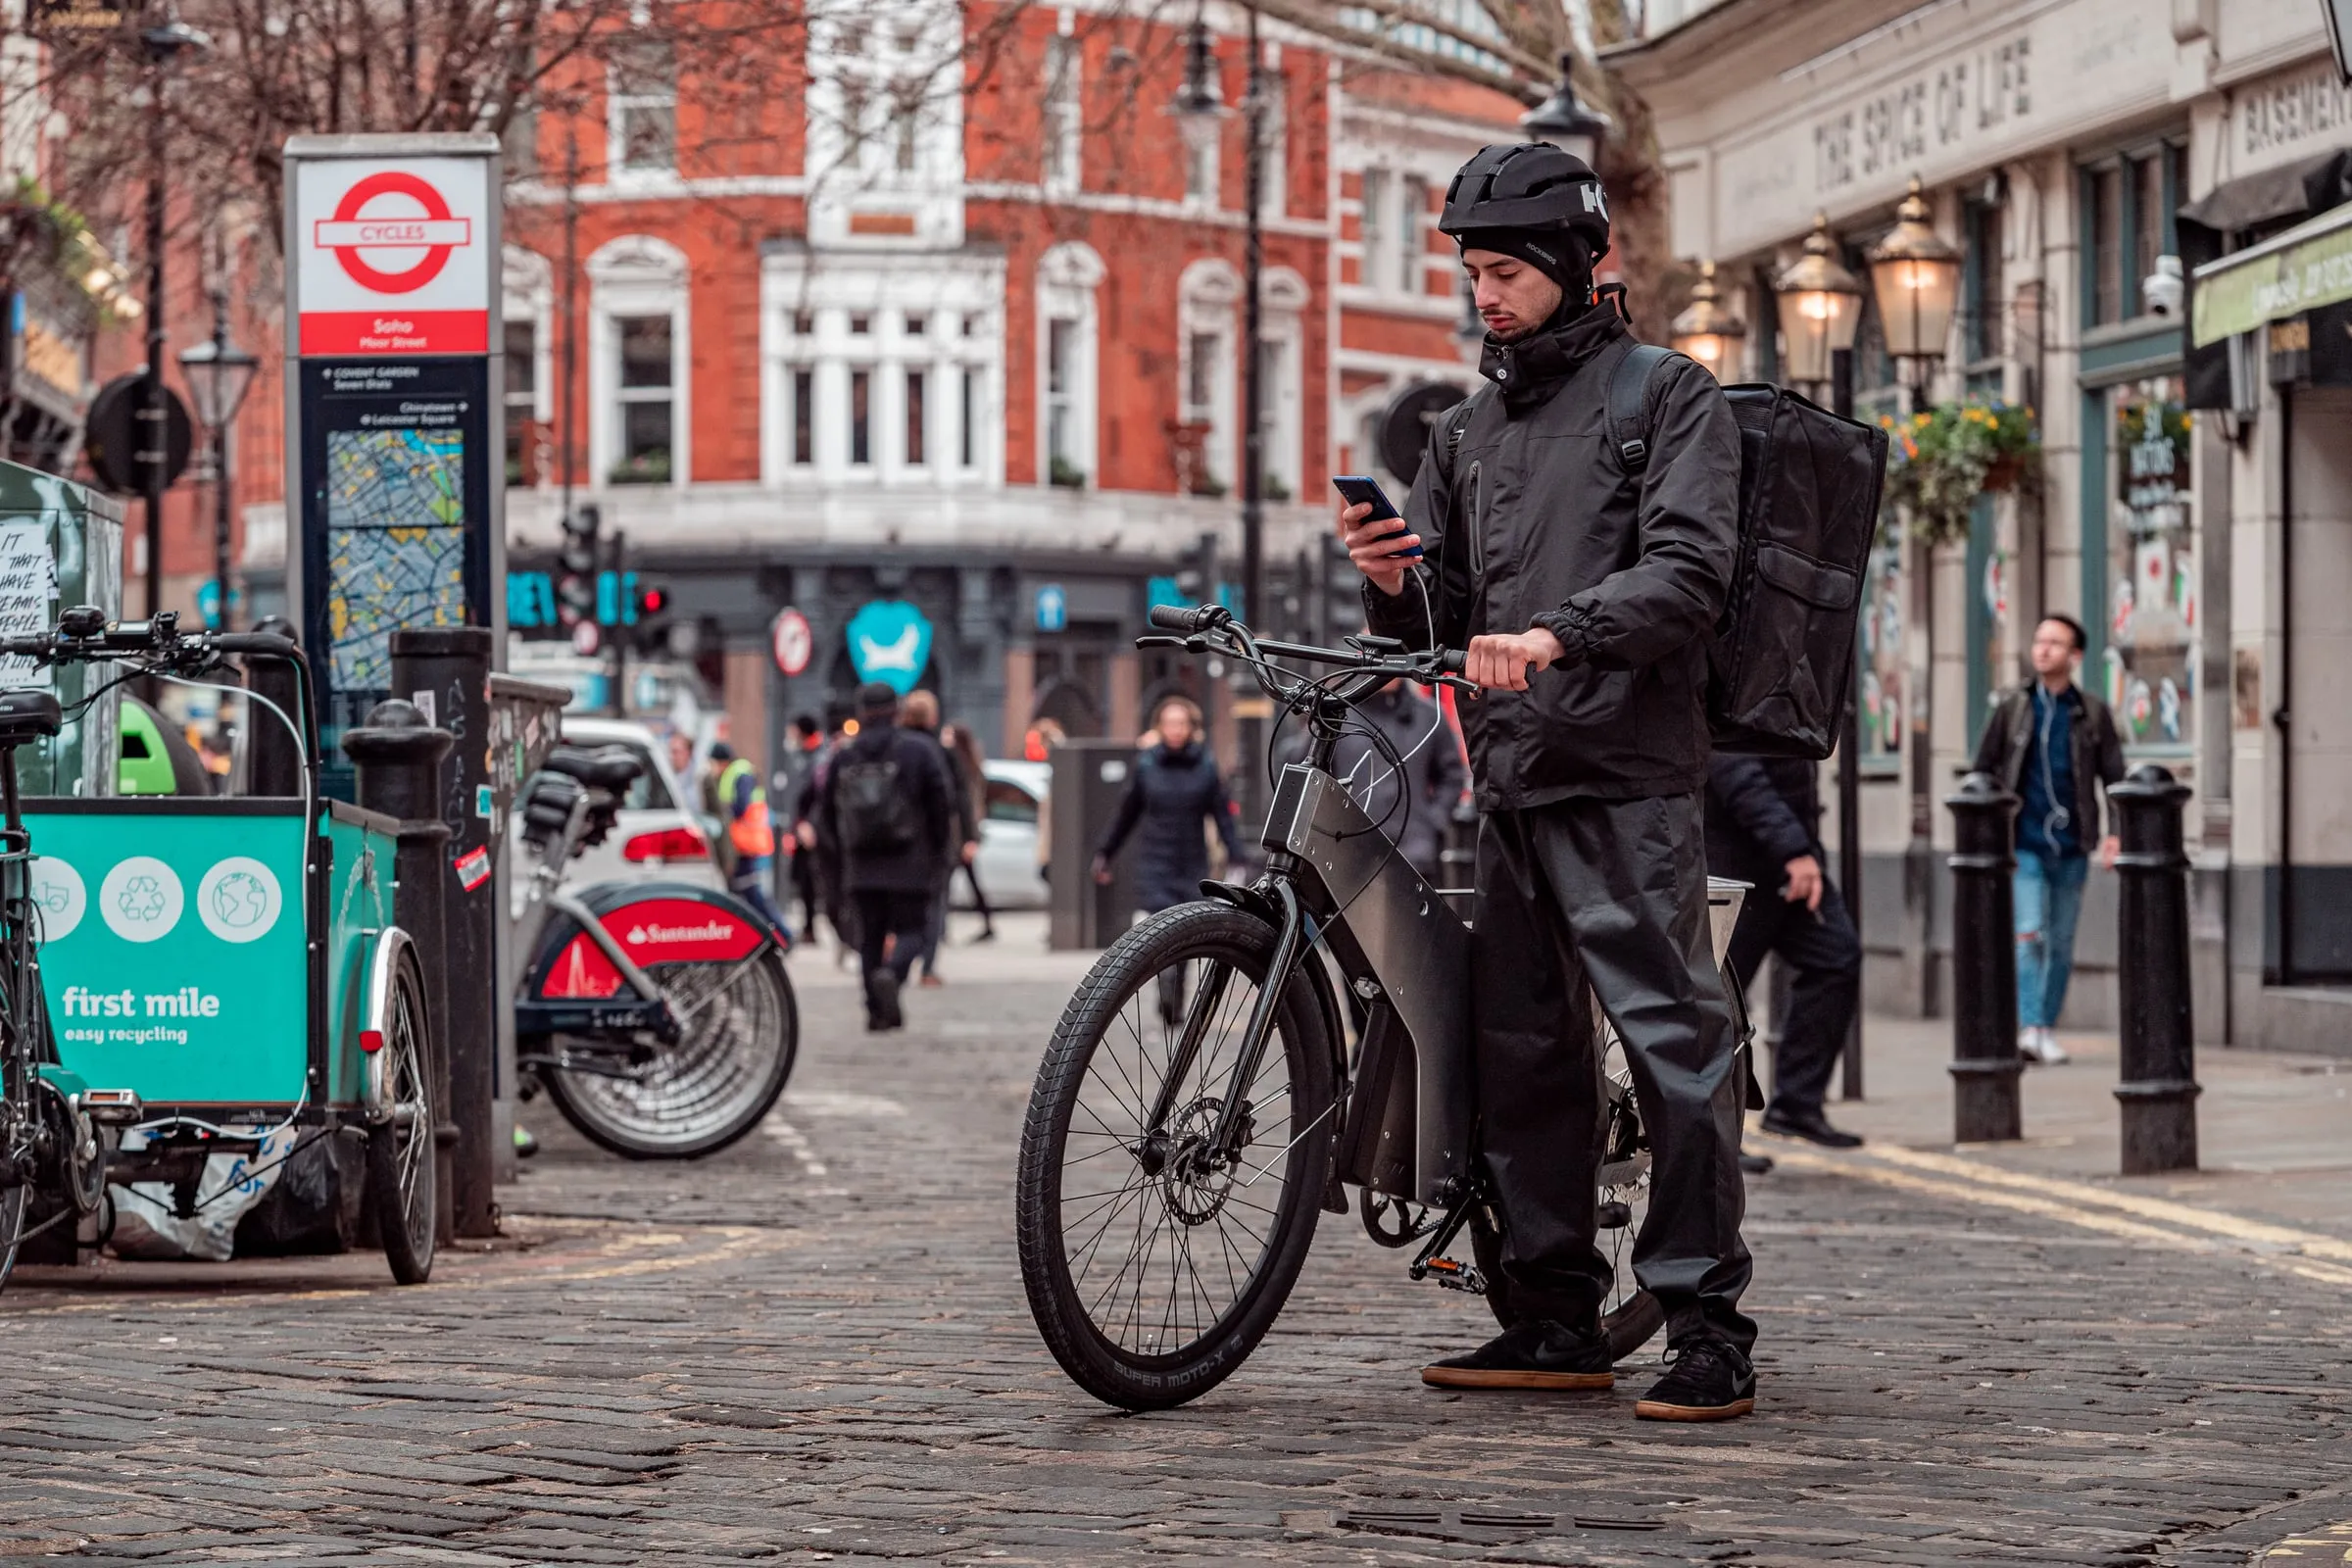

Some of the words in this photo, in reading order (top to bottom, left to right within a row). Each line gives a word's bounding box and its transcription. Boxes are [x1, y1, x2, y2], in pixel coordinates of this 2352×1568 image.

[1815, 112, 1853, 190] THE
[1864, 80, 1925, 172] SPICE
[1936, 64, 1967, 145] OF
[1977, 37, 2031, 129] LIFE
[2246, 73, 2352, 155] BASEMEN
[360, 224, 425, 241] CYCLES
[373, 318, 414, 334] Soho
[360, 336, 389, 349] Moor
[392, 336, 427, 349] Street
[333, 368, 375, 379] COVENT
[376, 367, 419, 378] GARDEN
[400, 402, 456, 414] Chinatown
[420, 414, 457, 425] Square
[9, 553, 42, 569] THAT
[647, 919, 734, 944] Santander
[62, 986, 136, 1017] first
[144, 986, 220, 1017] mile
[65, 1029, 104, 1046] easy
[109, 1026, 188, 1046] recycling
[1113, 1360, 1161, 1388] SUPER
[1167, 1350, 1225, 1388] MOTO-X
